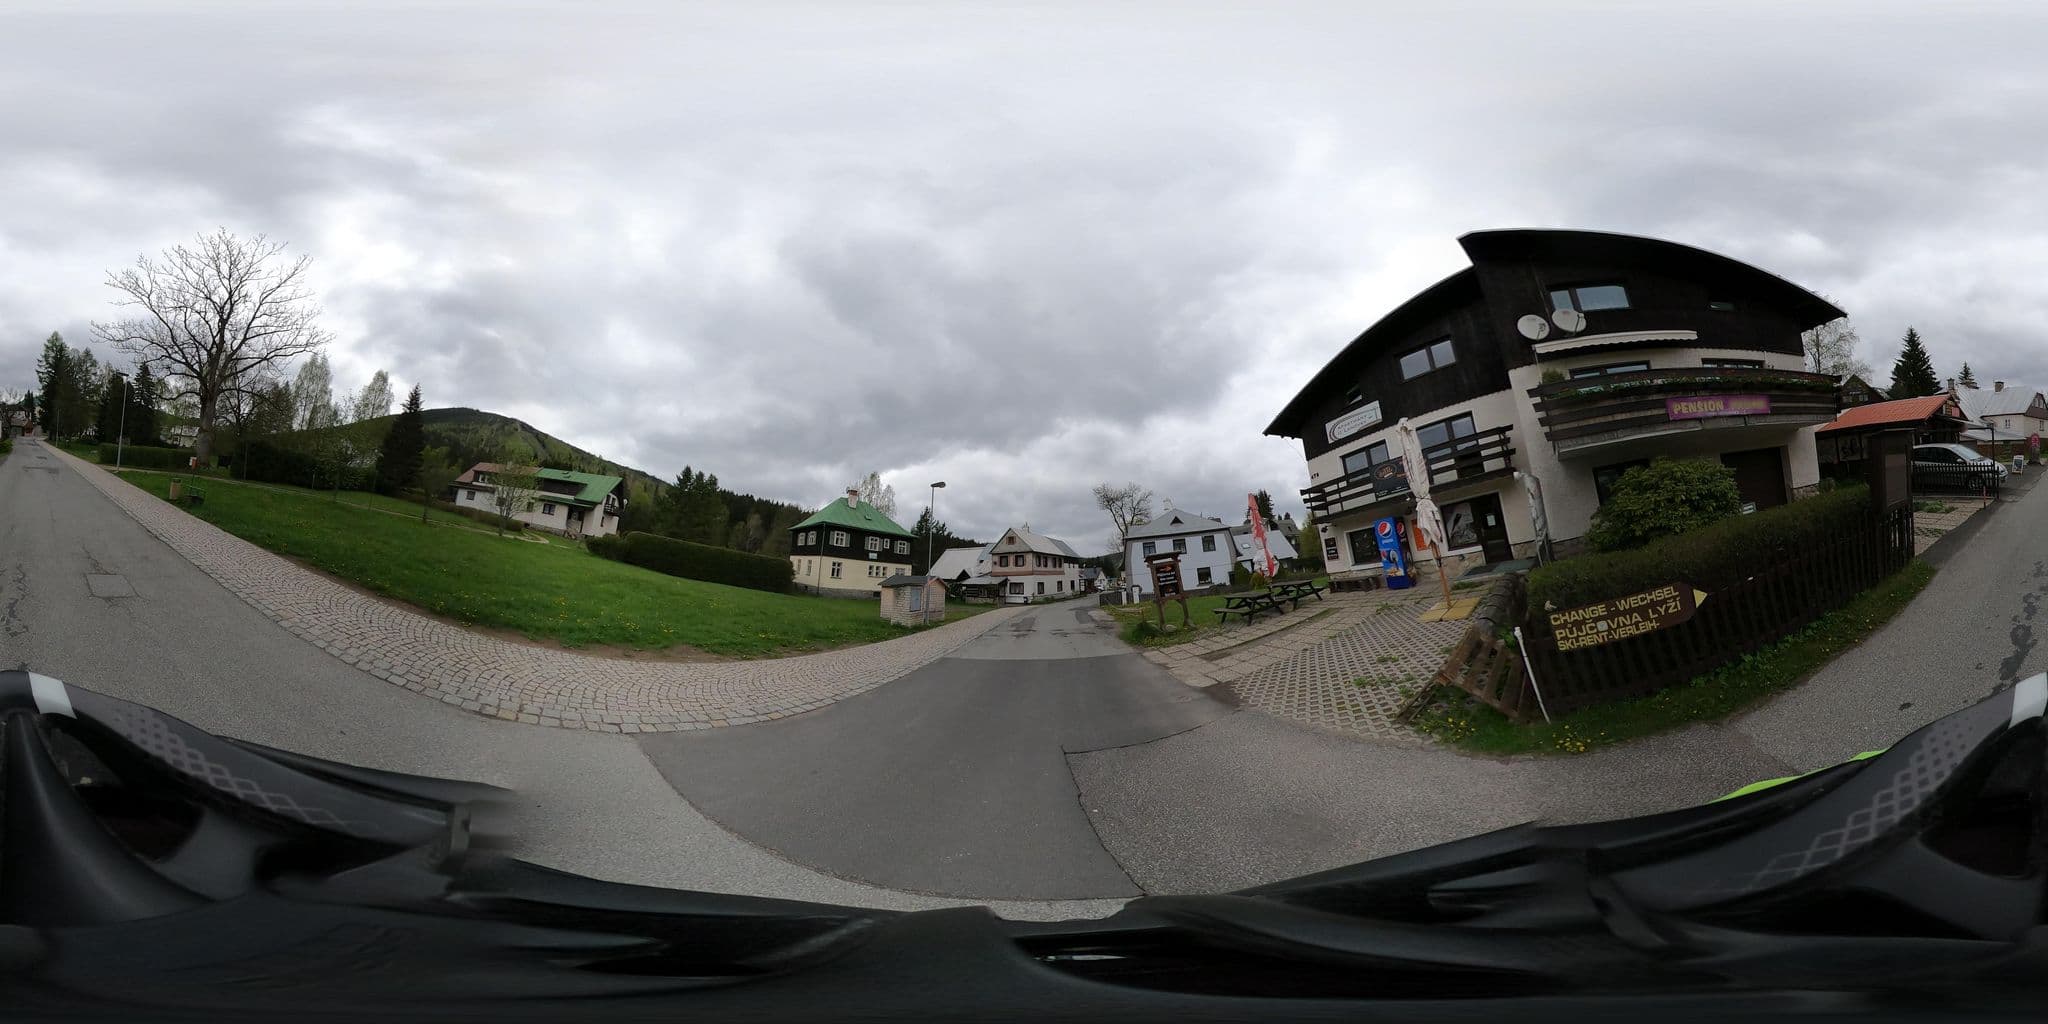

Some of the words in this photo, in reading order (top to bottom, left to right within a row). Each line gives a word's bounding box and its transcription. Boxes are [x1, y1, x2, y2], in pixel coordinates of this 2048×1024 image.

[1672, 400, 1724, 415] PENSION
[1550, 604, 1608, 626] CHANGE
[1616, 586, 1680, 611] WECHSEL
[1555, 612, 1643, 641] PŮJČVNA
[1649, 597, 1681, 619] LYŽÍ
